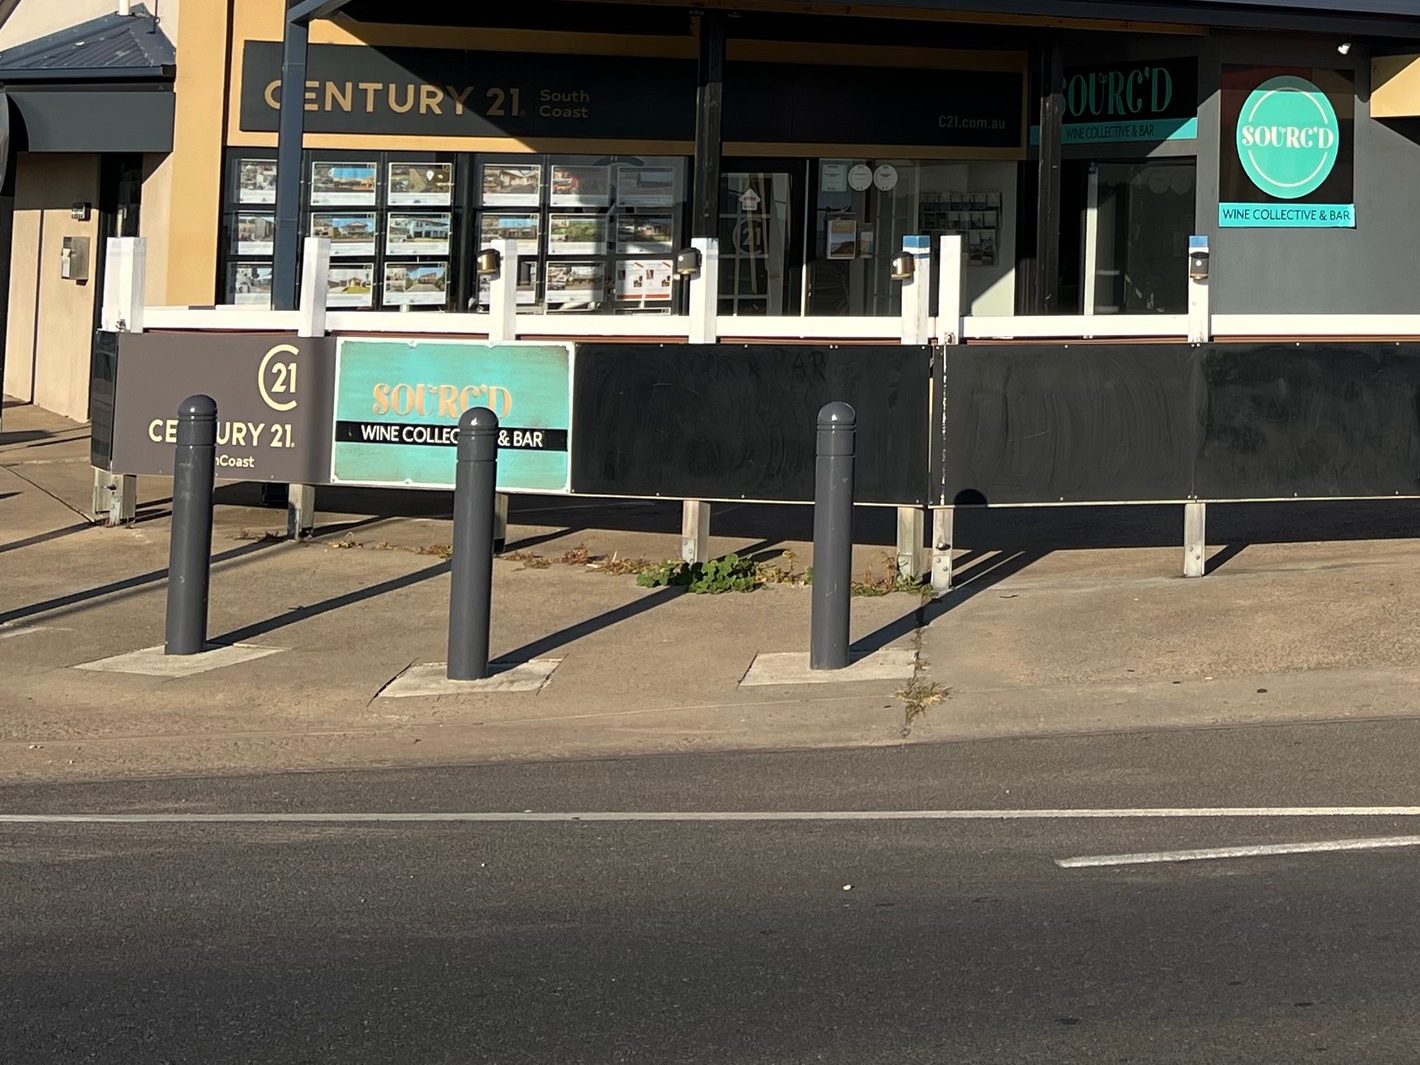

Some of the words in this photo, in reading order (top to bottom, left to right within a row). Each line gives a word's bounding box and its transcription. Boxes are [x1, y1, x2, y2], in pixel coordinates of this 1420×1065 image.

[264, 80, 475, 116] CENTURY
[486, 87, 522, 117] 21
[540, 89, 590, 103] South
[539, 104, 589, 119] Coast
[938, 114, 1006, 130] C21.com.au
[1066, 126, 1084, 140] WINE
[1086, 125, 1130, 139] COLLECTIVE
[1132, 124, 1138, 136] &
[1140, 124, 1154, 137] BAR
[1242, 125, 1334, 149] SOURC'D
[1222, 209, 1250, 220] WINE
[1253, 209, 1316, 220] COLLECTIVE
[1319, 210, 1328, 221] &
[1330, 210, 1350, 220] BAR
[372, 382, 512, 420] SOURC'D
[148, 418, 266, 447] CEURY
[270, 423, 292, 448] 21
[361, 424, 400, 442] WINE
[402, 426, 461, 445] COLLEC
[497, 430, 511, 447] &
[513, 430, 543, 448] BAR
